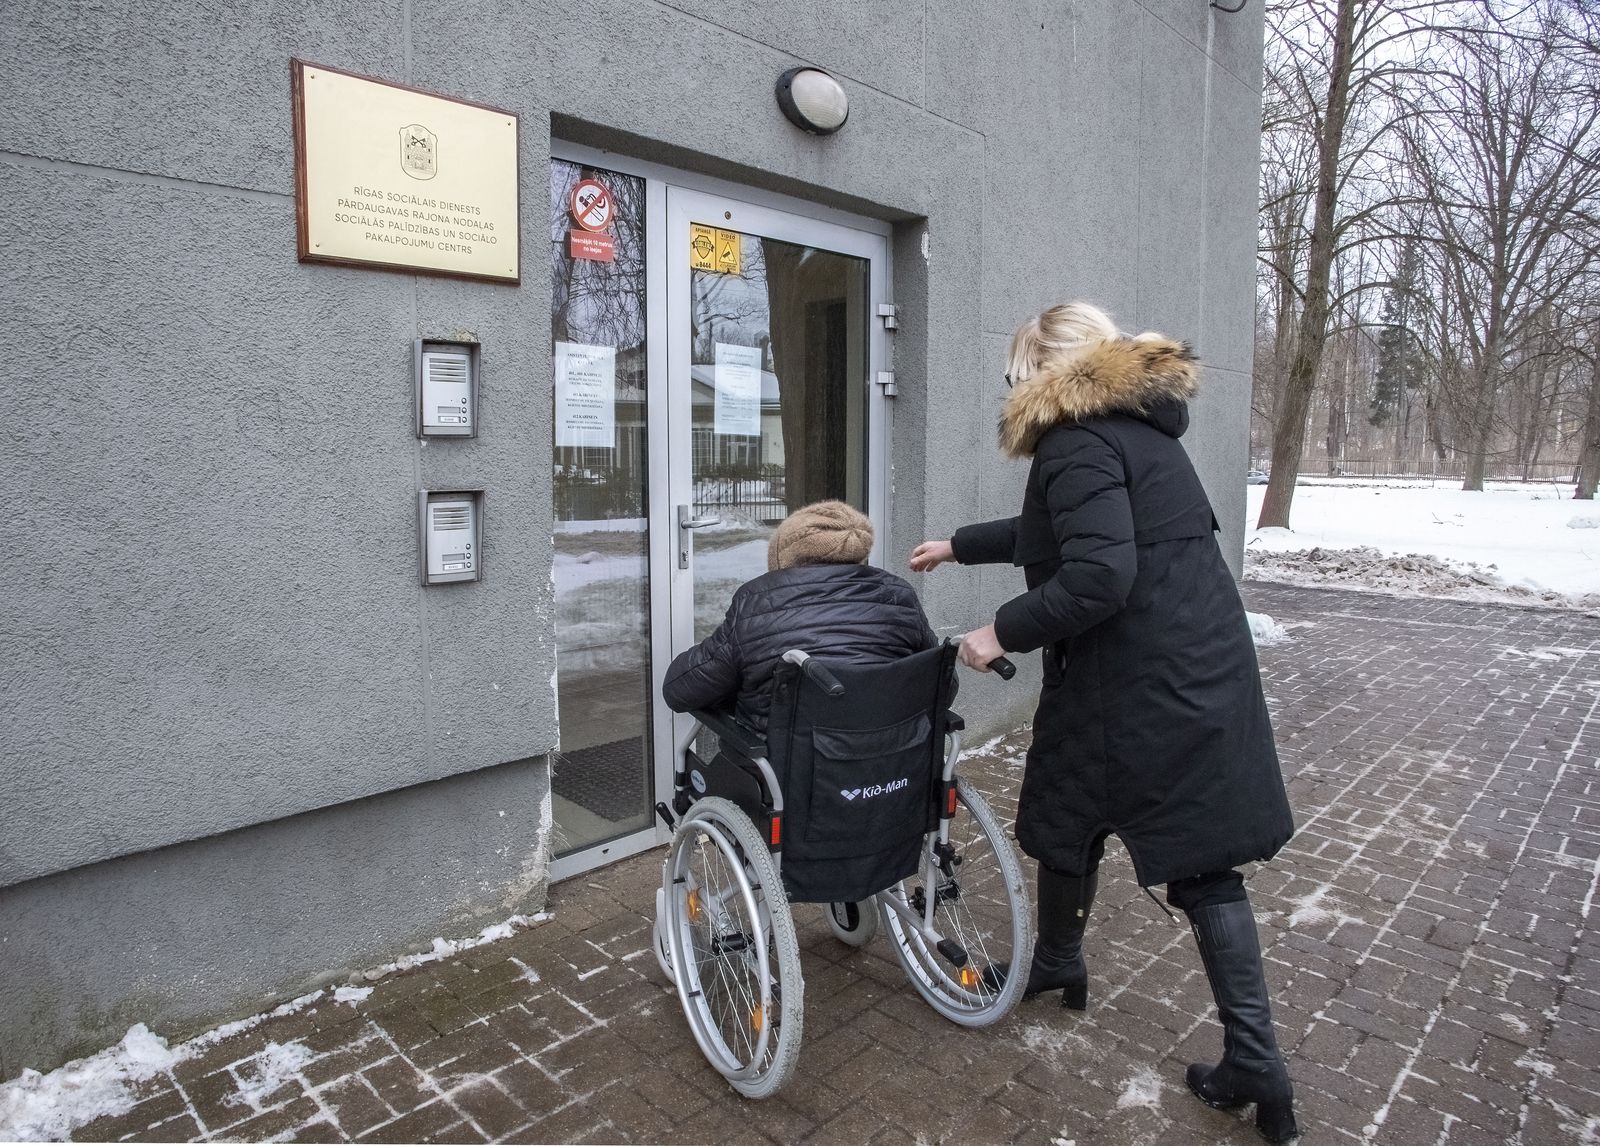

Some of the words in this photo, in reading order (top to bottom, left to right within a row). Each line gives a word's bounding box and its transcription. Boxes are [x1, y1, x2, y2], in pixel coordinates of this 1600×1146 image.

[337, 198, 410, 218] PĀRDAUGAVAS
[412, 210, 451, 225] RAJONA
[353, 186, 384, 200] RĪGAS
[387, 192, 437, 208] SOCIĀLAIS
[439, 201, 481, 216] DIENESTS
[335, 213, 385, 228] SOCIĀLĀS
[388, 220, 440, 236] PALĪDZĪBAS
[443, 229, 456, 239] UN
[458, 232, 498, 245] SOCIĀLO
[365, 232, 435, 249] PAKALPOJUMU
[438, 242, 473, 254] CENTRS
[862, 778, 908, 799] Kid-Man
